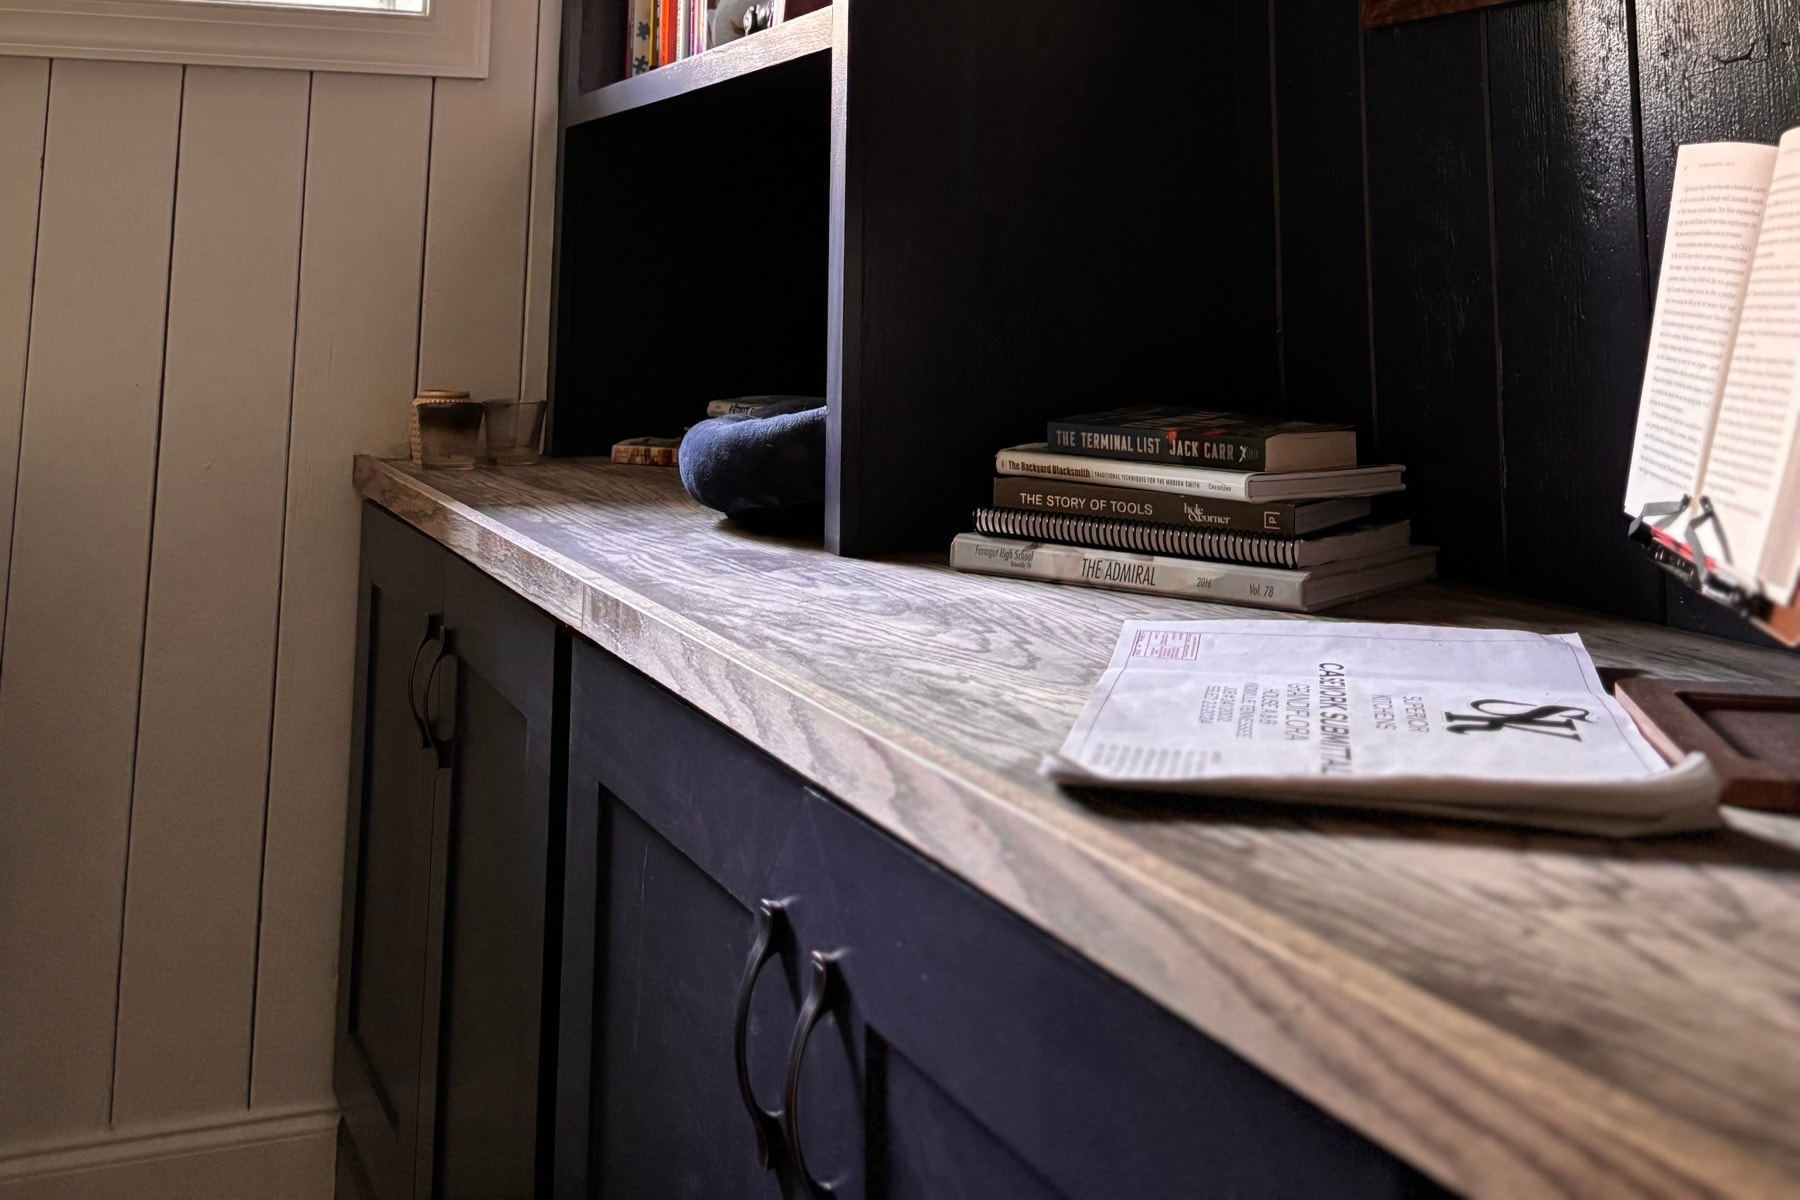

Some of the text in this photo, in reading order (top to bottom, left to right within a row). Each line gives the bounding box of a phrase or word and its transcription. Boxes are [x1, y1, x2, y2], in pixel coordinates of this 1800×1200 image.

[1056, 430, 1160, 455] THE TERMINAL LIST
[1169, 439, 1198, 458] JACK
[1204, 442, 1234, 461] CARR
[1008, 460, 1020, 471] The
[1021, 461, 1052, 474] Backyard
[1052, 464, 1091, 478] Blacksmith
[1094, 471, 1200, 489] TRADITIONAL TECHNIQUES FOR THE MODERN SMITH
[1020, 492, 1153, 515] THE STORY OF TOOLS
[1000, 547, 1013, 561] High
[1014, 548, 1035, 562] School
[1081, 557, 1156, 586] THE ADMIRAL
[1197, 577, 1212, 589] 2016
[1250, 583, 1275, 598] Vol. 78
[1261, 689, 1280, 708] HOUSE
[1285, 683, 1310, 741] GRANDIFLORA
[1319, 662, 1353, 775] CASEWORK SUBMITTAL
[1371, 693, 1397, 730] KITCHENS
[1402, 695, 1430, 733] SUPERIOR
